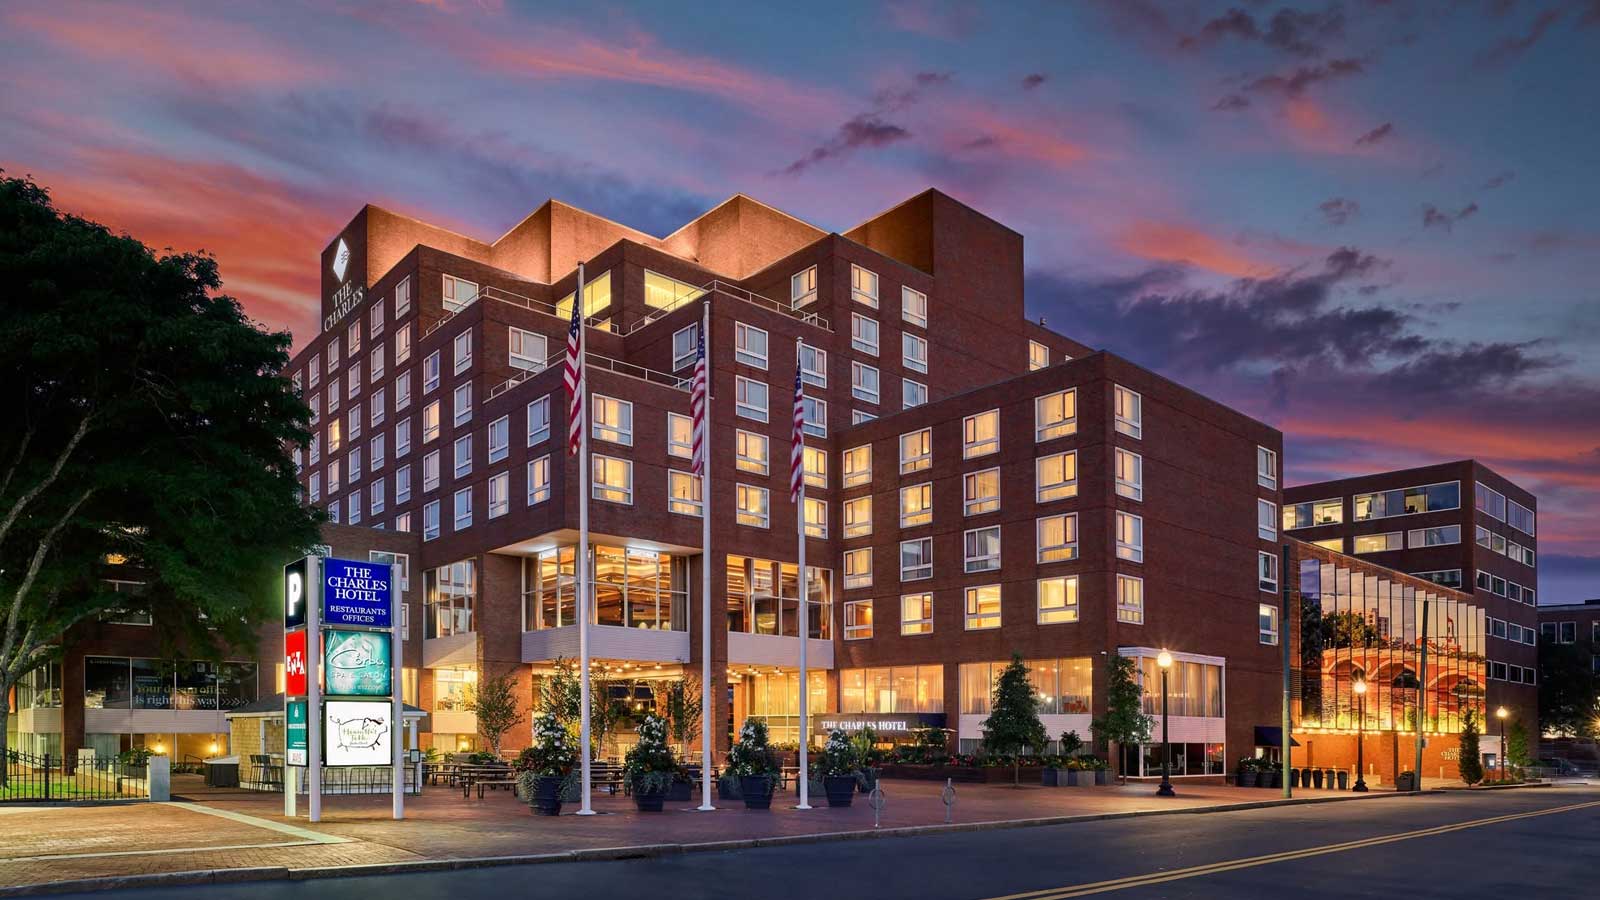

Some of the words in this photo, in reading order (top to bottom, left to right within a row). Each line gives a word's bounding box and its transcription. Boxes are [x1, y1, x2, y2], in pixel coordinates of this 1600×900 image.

[332, 280, 352, 307] THE
[324, 286, 363, 332] CHARLES
[343, 566, 373, 579] THE
[327, 576, 388, 591] CHARLES
[288, 572, 301, 616] P
[335, 588, 381, 602] HOTEL
[330, 605, 387, 616] RESTAURANTS
[342, 614, 375, 623] OFFICES
[821, 720, 838, 730] THE
[878, 721, 908, 731] HOTEL
